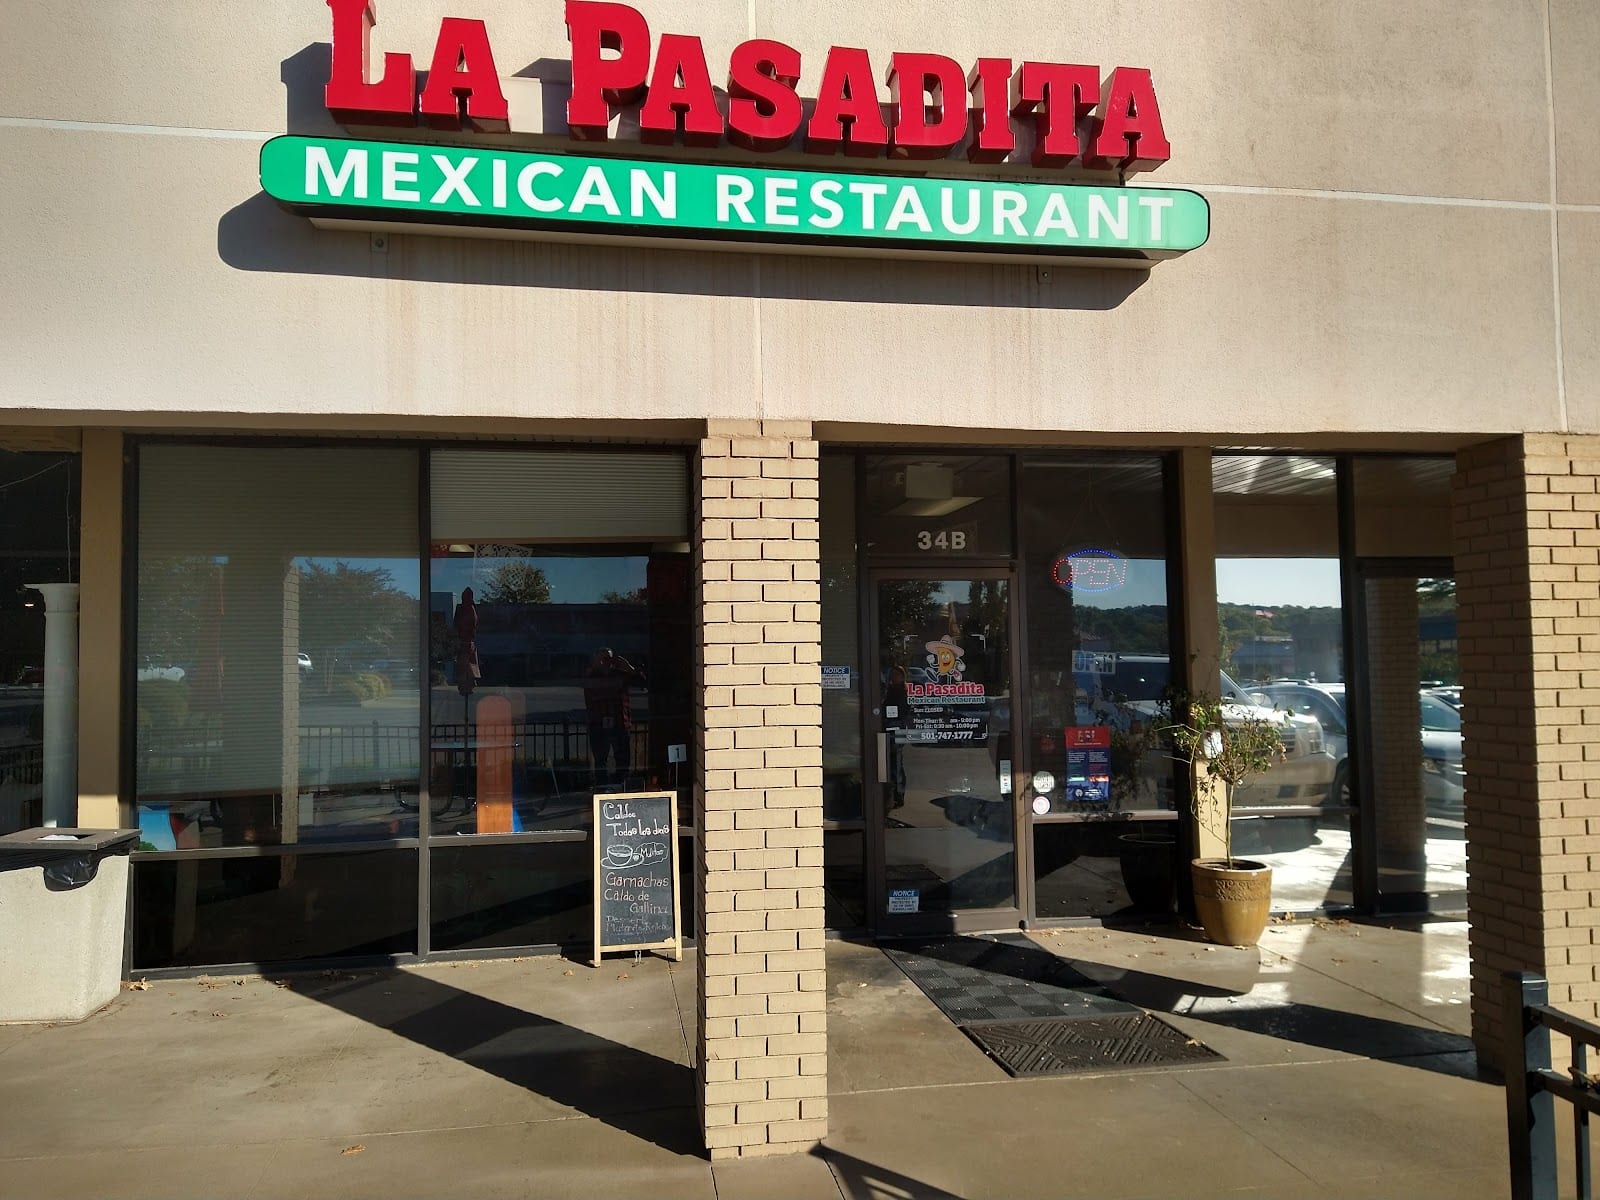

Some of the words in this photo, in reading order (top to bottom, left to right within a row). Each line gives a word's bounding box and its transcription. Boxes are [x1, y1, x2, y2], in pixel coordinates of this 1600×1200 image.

[324, 0, 509, 121] LA
[565, 0, 1171, 162] PASADITA
[304, 145, 677, 220] MEXICAN
[715, 174, 1174, 242] RESTAURANT
[917, 530, 966, 550] 34B
[1053, 557, 1127, 585] OPEN
[1074, 651, 1113, 673] OPEN
[907, 683, 923, 696] La
[925, 682, 985, 696] Pasadita
[907, 696, 941, 704] Mexican
[941, 696, 986, 704] Restaurant
[921, 731, 974, 740] 501-747-1777
[606, 822, 637, 836] Todos
[638, 818, 651, 836] los
[605, 871, 669, 888] Garnachas
[604, 888, 635, 902] Caldo
[637, 890, 650, 902] de
[629, 902, 668, 914] Gallina
